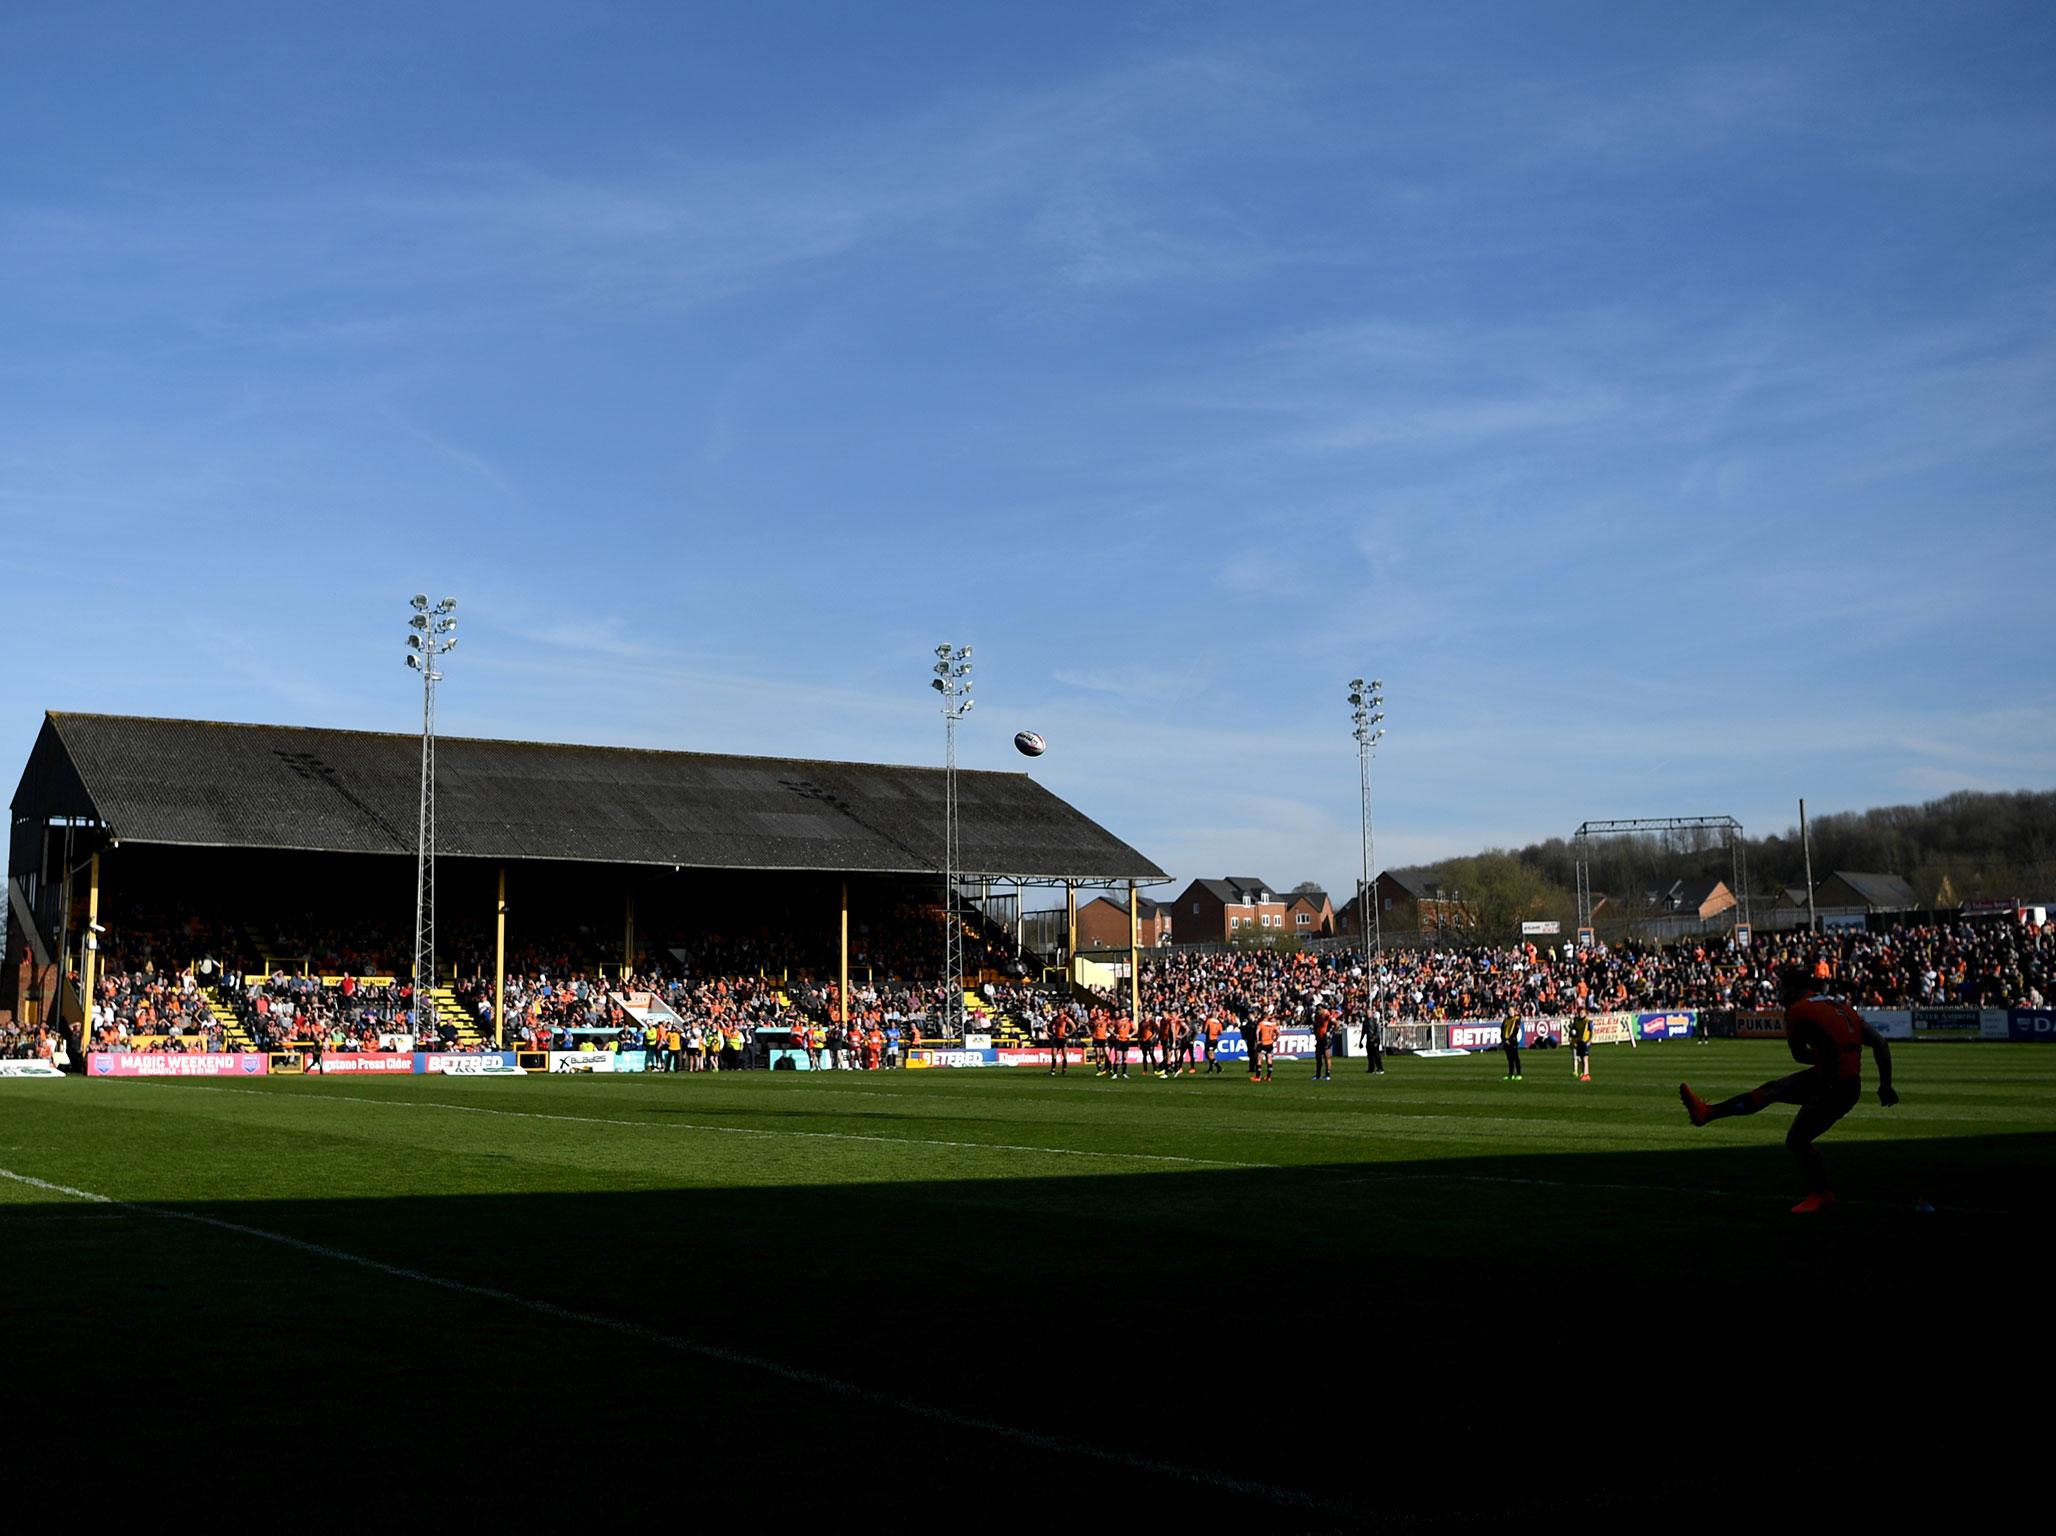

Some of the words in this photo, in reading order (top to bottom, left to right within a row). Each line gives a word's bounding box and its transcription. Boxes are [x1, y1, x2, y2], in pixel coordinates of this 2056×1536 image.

[1737, 1018, 1782, 1031] PUKKA
[1452, 1027, 1503, 1046] BETFR
[121, 1056, 166, 1068] MAGIC
[168, 1056, 235, 1068] WEEKEND
[358, 1057, 385, 1069] Press
[386, 1057, 412, 1069] Cider
